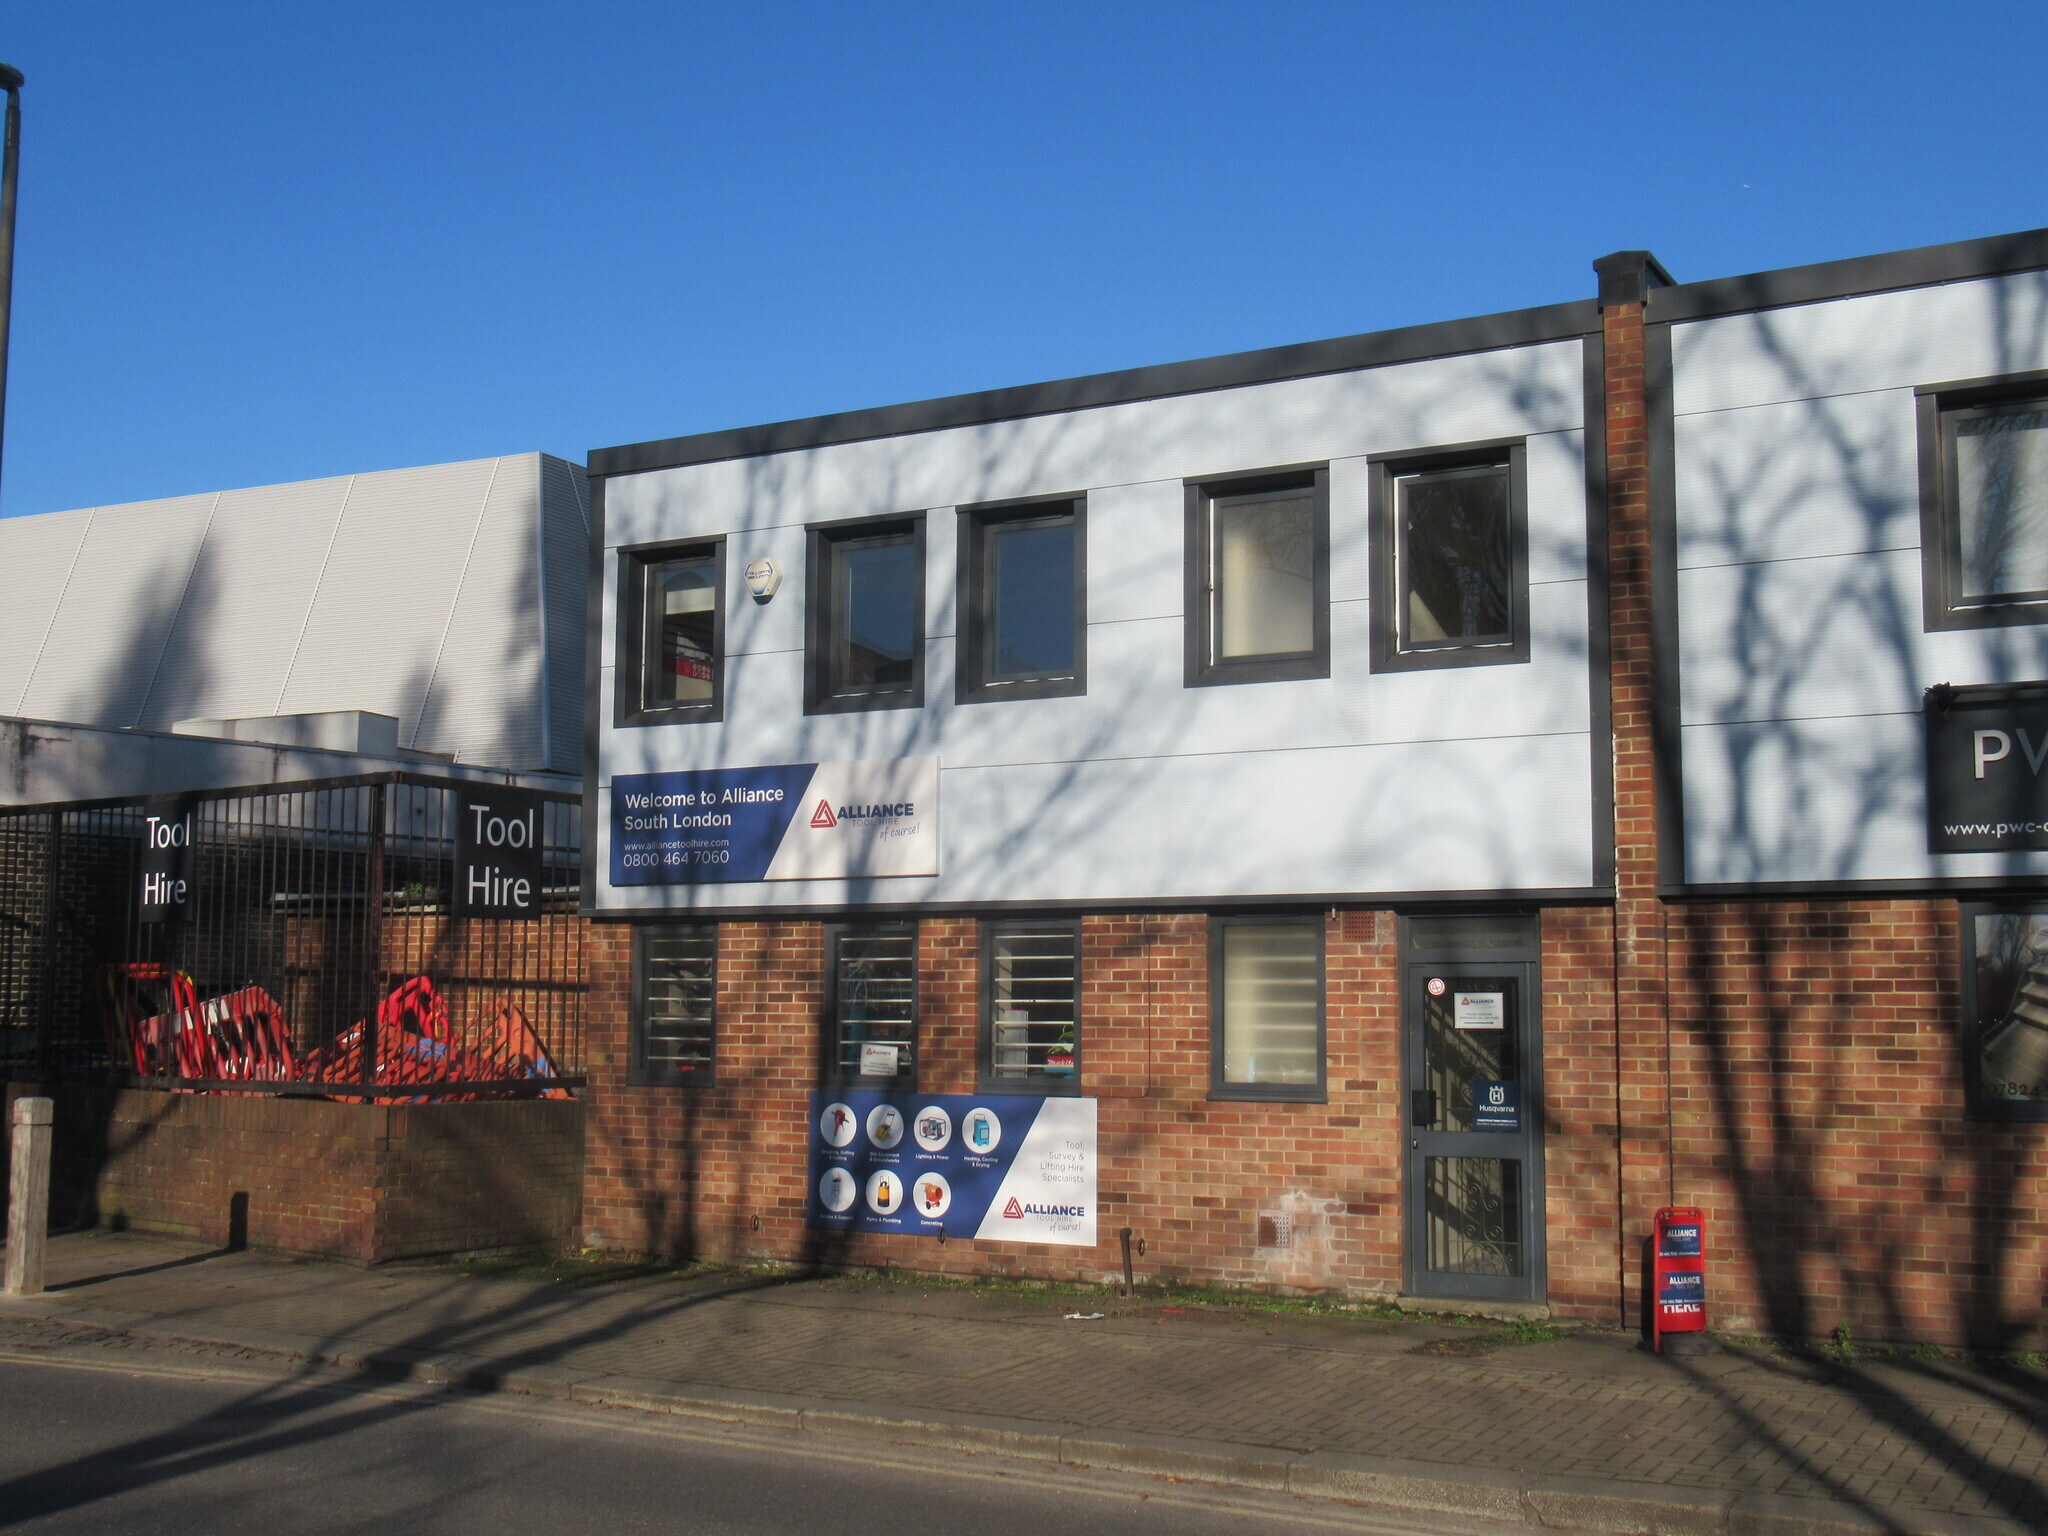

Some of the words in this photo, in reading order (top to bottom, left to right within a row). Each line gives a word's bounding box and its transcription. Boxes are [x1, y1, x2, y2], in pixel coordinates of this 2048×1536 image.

[625, 793, 696, 809] Welcome
[700, 790, 716, 805] to
[721, 787, 784, 804] Alliance
[837, 803, 914, 819] ALLIANCE
[469, 804, 534, 849] Tool
[624, 813, 668, 831] South
[673, 811, 731, 828] London
[852, 819, 876, 827] TOOL
[878, 817, 899, 826] HIRE
[145, 812, 190, 849] Tool
[880, 826, 889, 842] of
[890, 822, 920, 838] course!
[624, 838, 729, 851] www.alliancetoolhire.com
[623, 852, 659, 867] 0800
[663, 851, 689, 866] 464
[694, 850, 729, 864] 7060
[143, 872, 187, 906] Hire
[467, 865, 531, 908] Hire
[1479, 1104, 1515, 1113] Husqvarna
[1066, 1141, 1085, 1151] Tool,
[1049, 1151, 1077, 1161] Survey
[1078, 1152, 1084, 1160] &
[1040, 1162, 1066, 1172] Lifting
[1068, 1163, 1085, 1172] Hire
[1042, 1173, 1085, 1183] Specialists
[1024, 1203, 1085, 1217] ALLIANCE
[1667, 1229, 1697, 1237] ALLIANCE
[1669, 1276, 1700, 1285] ALLIANCE
